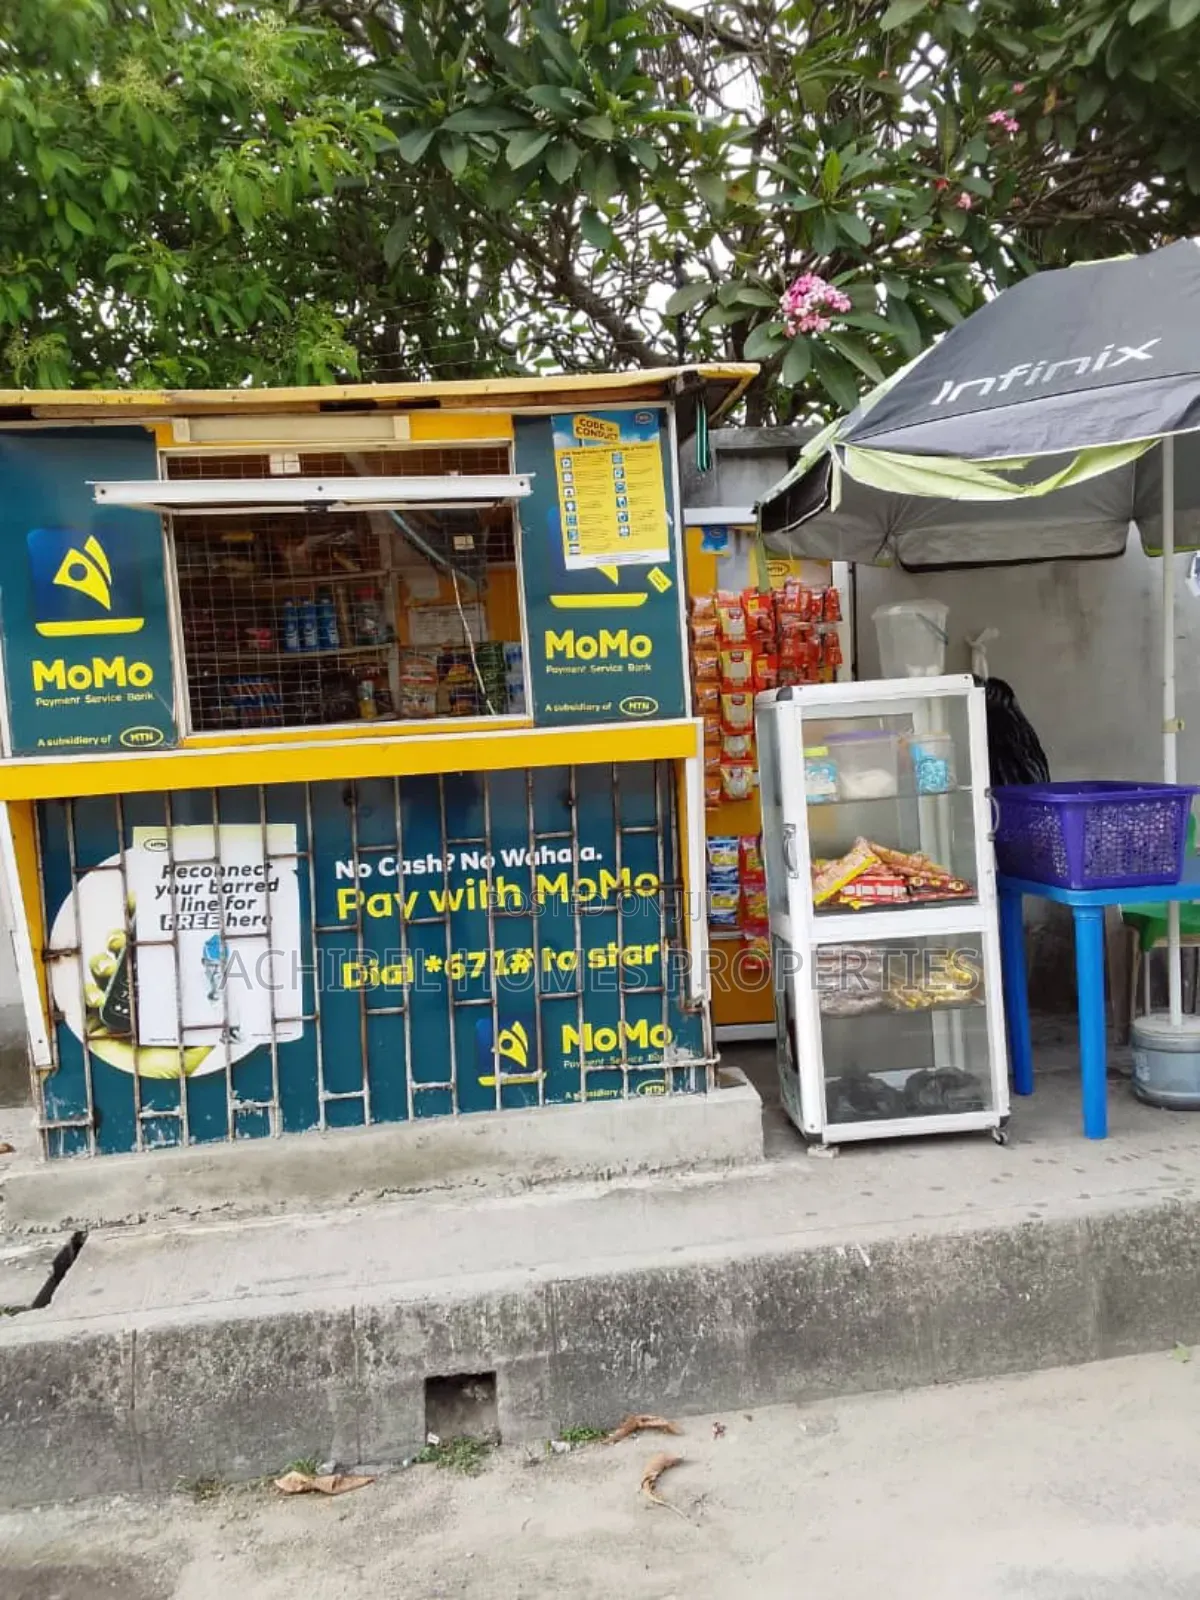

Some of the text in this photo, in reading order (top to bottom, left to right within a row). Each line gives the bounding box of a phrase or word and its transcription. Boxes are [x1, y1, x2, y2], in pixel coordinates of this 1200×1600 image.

[930, 337, 1162, 406] Infinix
[575, 426, 618, 441] CONDUCT
[578, 417, 606, 431] CODE
[544, 629, 653, 660] MoMo
[32, 655, 154, 692] MoMo
[546, 662, 652, 675] Payment Service Bank
[36, 690, 155, 708] Payment Service Bank
[544, 701, 650, 713] A subsidiary of MTN
[37, 737, 46, 748] A
[47, 734, 100, 747] subsidiary
[100, 733, 113, 745] of
[335, 845, 603, 880] No Cash? No Wahaa.
[336, 866, 661, 921] Pay with MoMo
[180, 894, 258, 913] line for
[342, 954, 415, 991] Dial
[541, 946, 579, 974] to
[561, 1018, 673, 1055] MoMo
[563, 1057, 604, 1069] Payent
